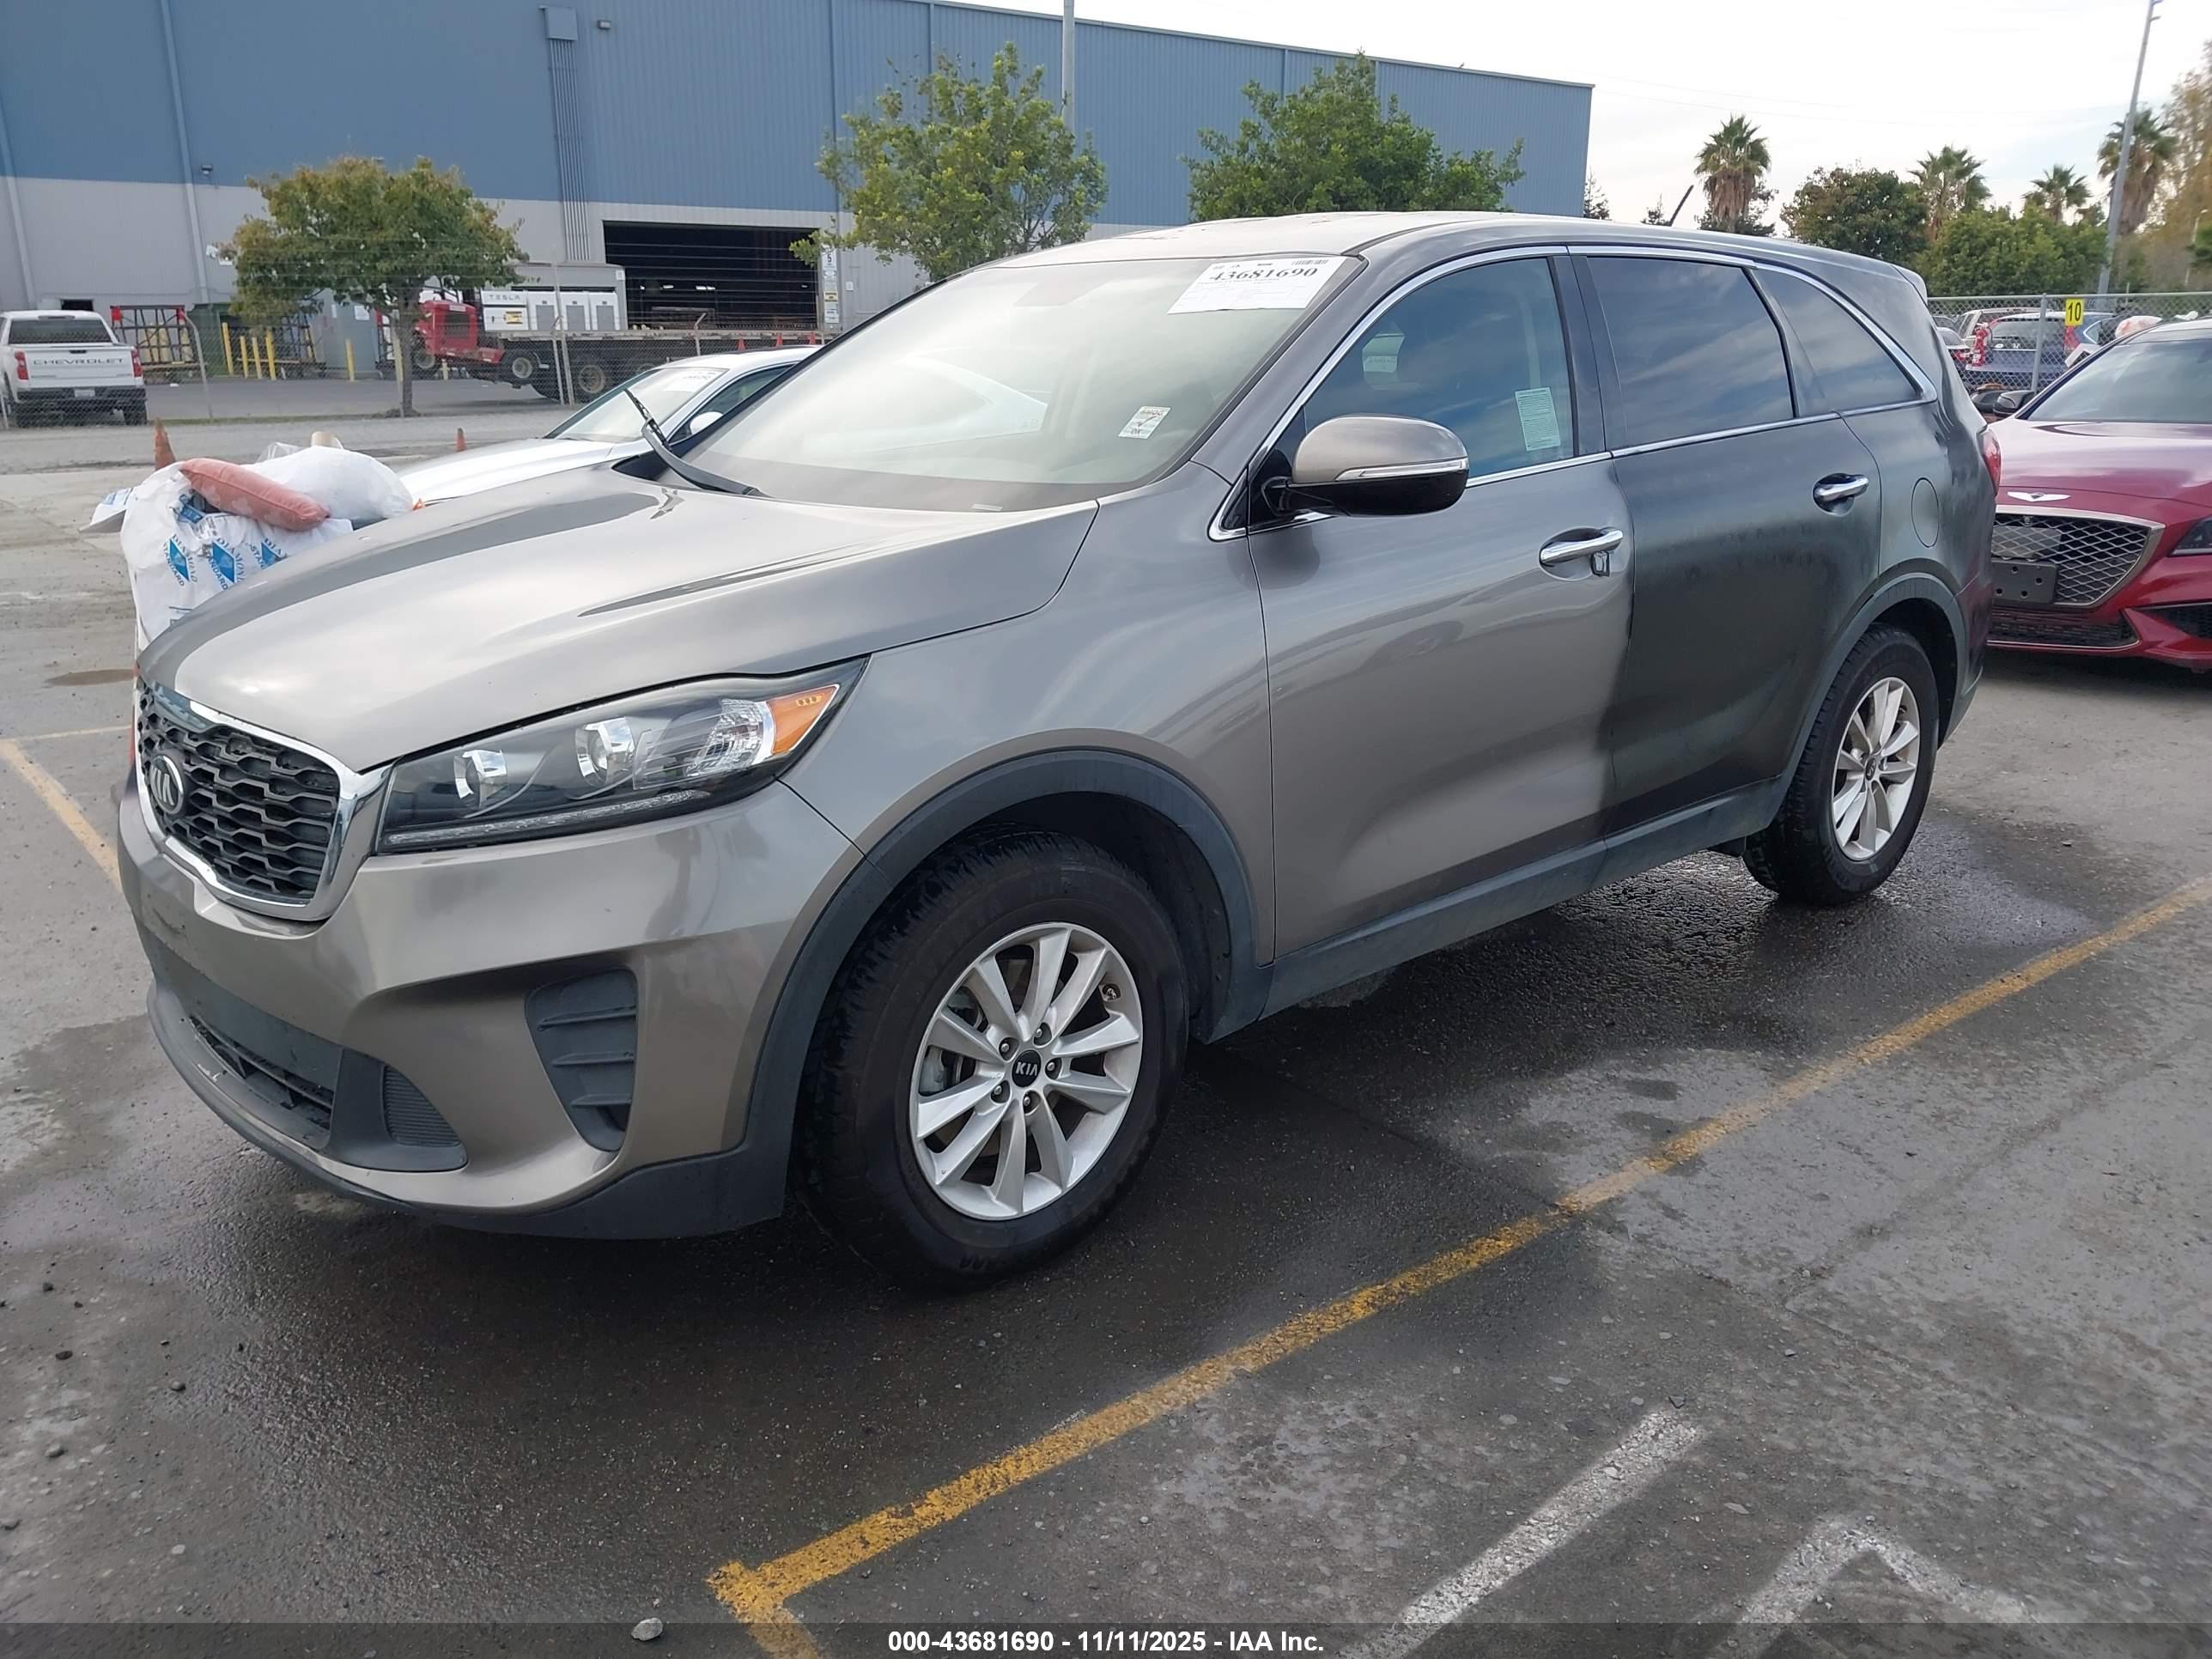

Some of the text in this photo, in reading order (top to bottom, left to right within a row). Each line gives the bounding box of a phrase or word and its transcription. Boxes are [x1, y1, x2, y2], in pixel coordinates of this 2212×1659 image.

[1209, 267, 1318, 281] 43681690
[2068, 301, 2081, 322] 10
[1015, 1061, 1038, 1076] KIA
